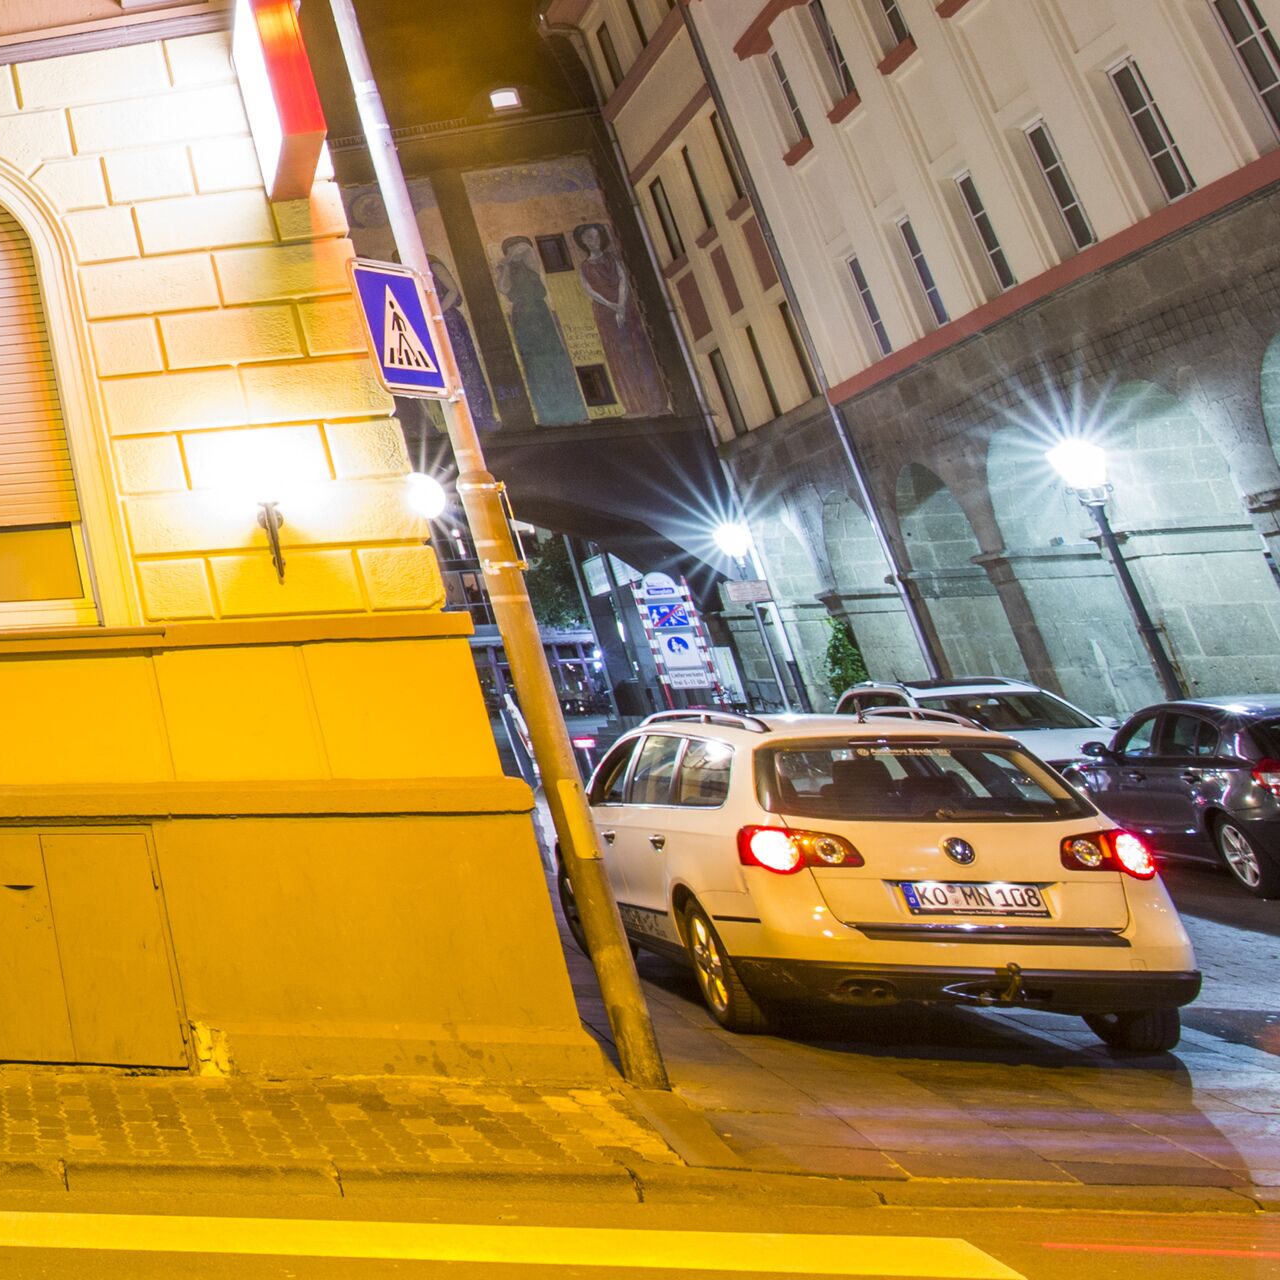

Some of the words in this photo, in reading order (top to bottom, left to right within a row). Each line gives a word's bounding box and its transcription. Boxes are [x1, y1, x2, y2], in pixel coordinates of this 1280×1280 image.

[914, 885, 949, 906] KO
[961, 886, 995, 907] MN
[996, 888, 1041, 907] 108
